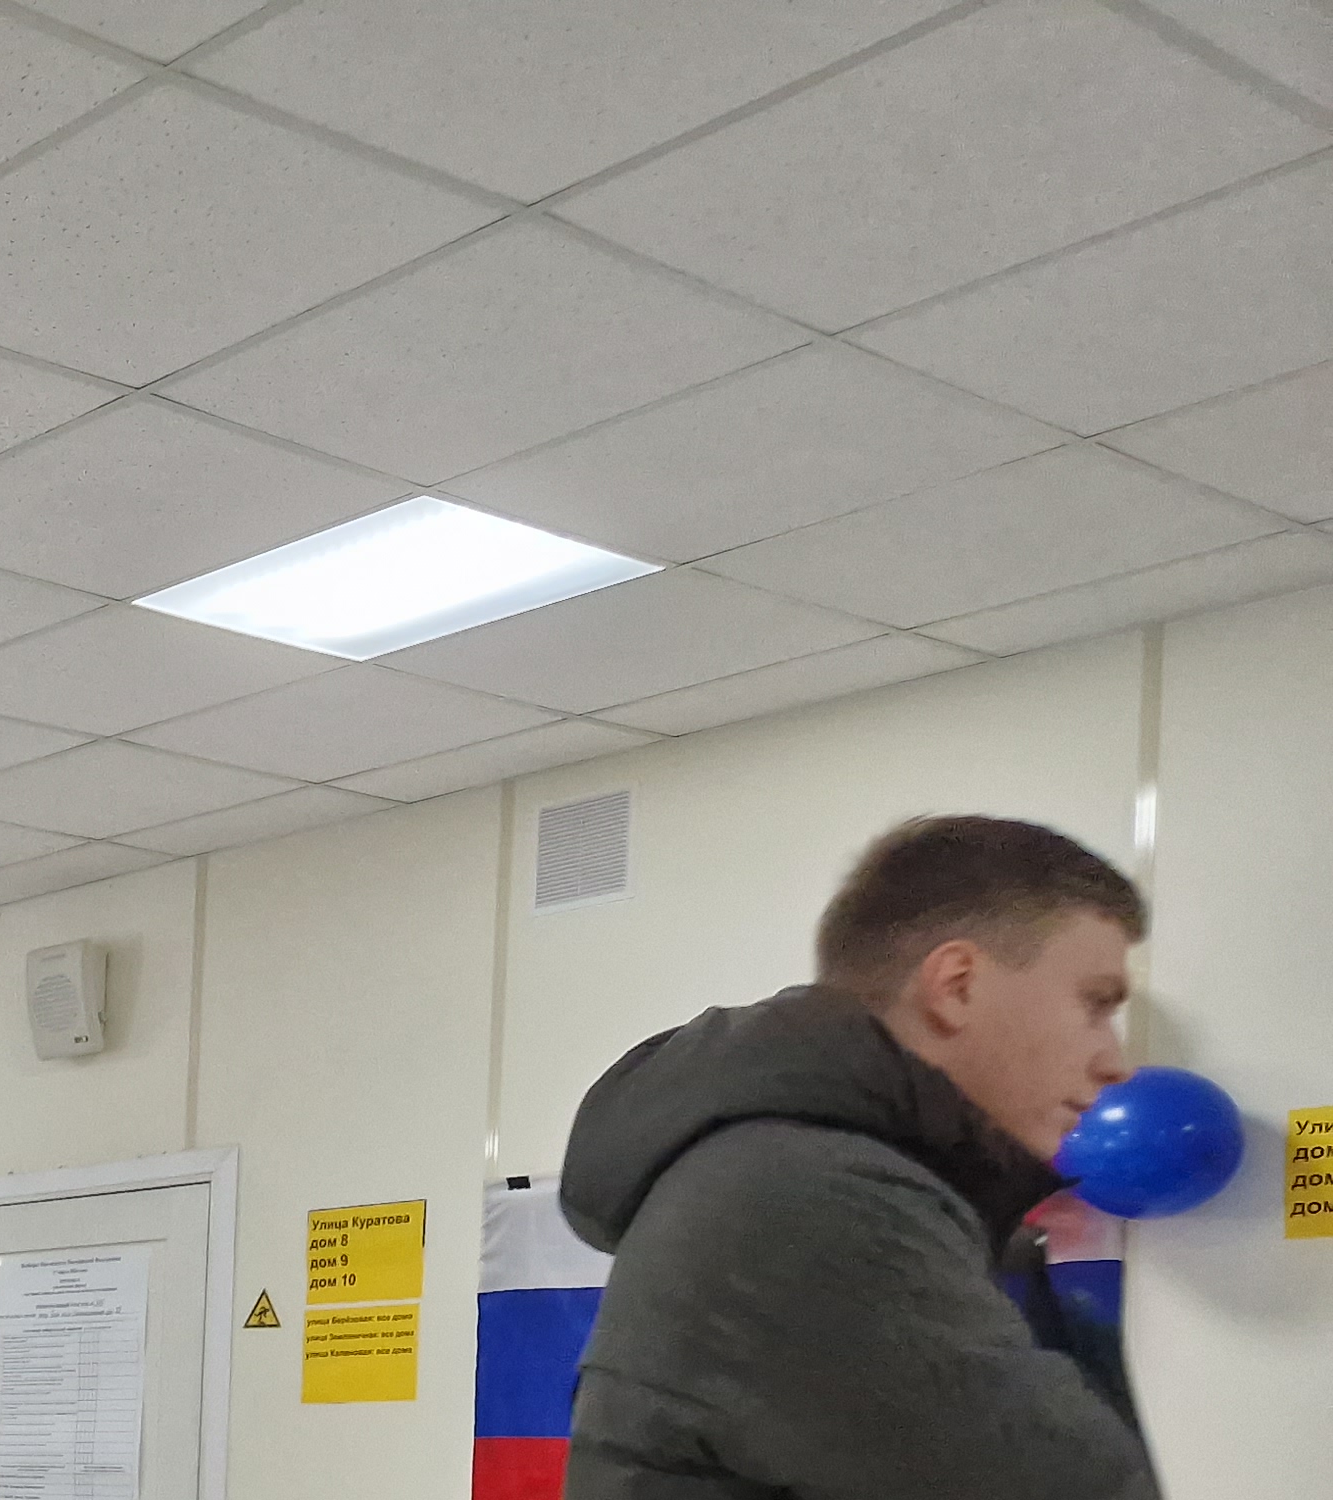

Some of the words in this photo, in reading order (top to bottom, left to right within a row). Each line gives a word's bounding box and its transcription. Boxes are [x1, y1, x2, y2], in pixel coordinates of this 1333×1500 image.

[312, 1219, 348, 1231] Улица
[352, 1215, 410, 1229] Куратова
[310, 1238, 337, 1250] дом
[341, 1234, 348, 1246] 8
[310, 1258, 337, 1271] дом
[341, 1254, 348, 1267] 9
[310, 1278, 337, 1290] дом
[342, 1274, 356, 1287] 10
